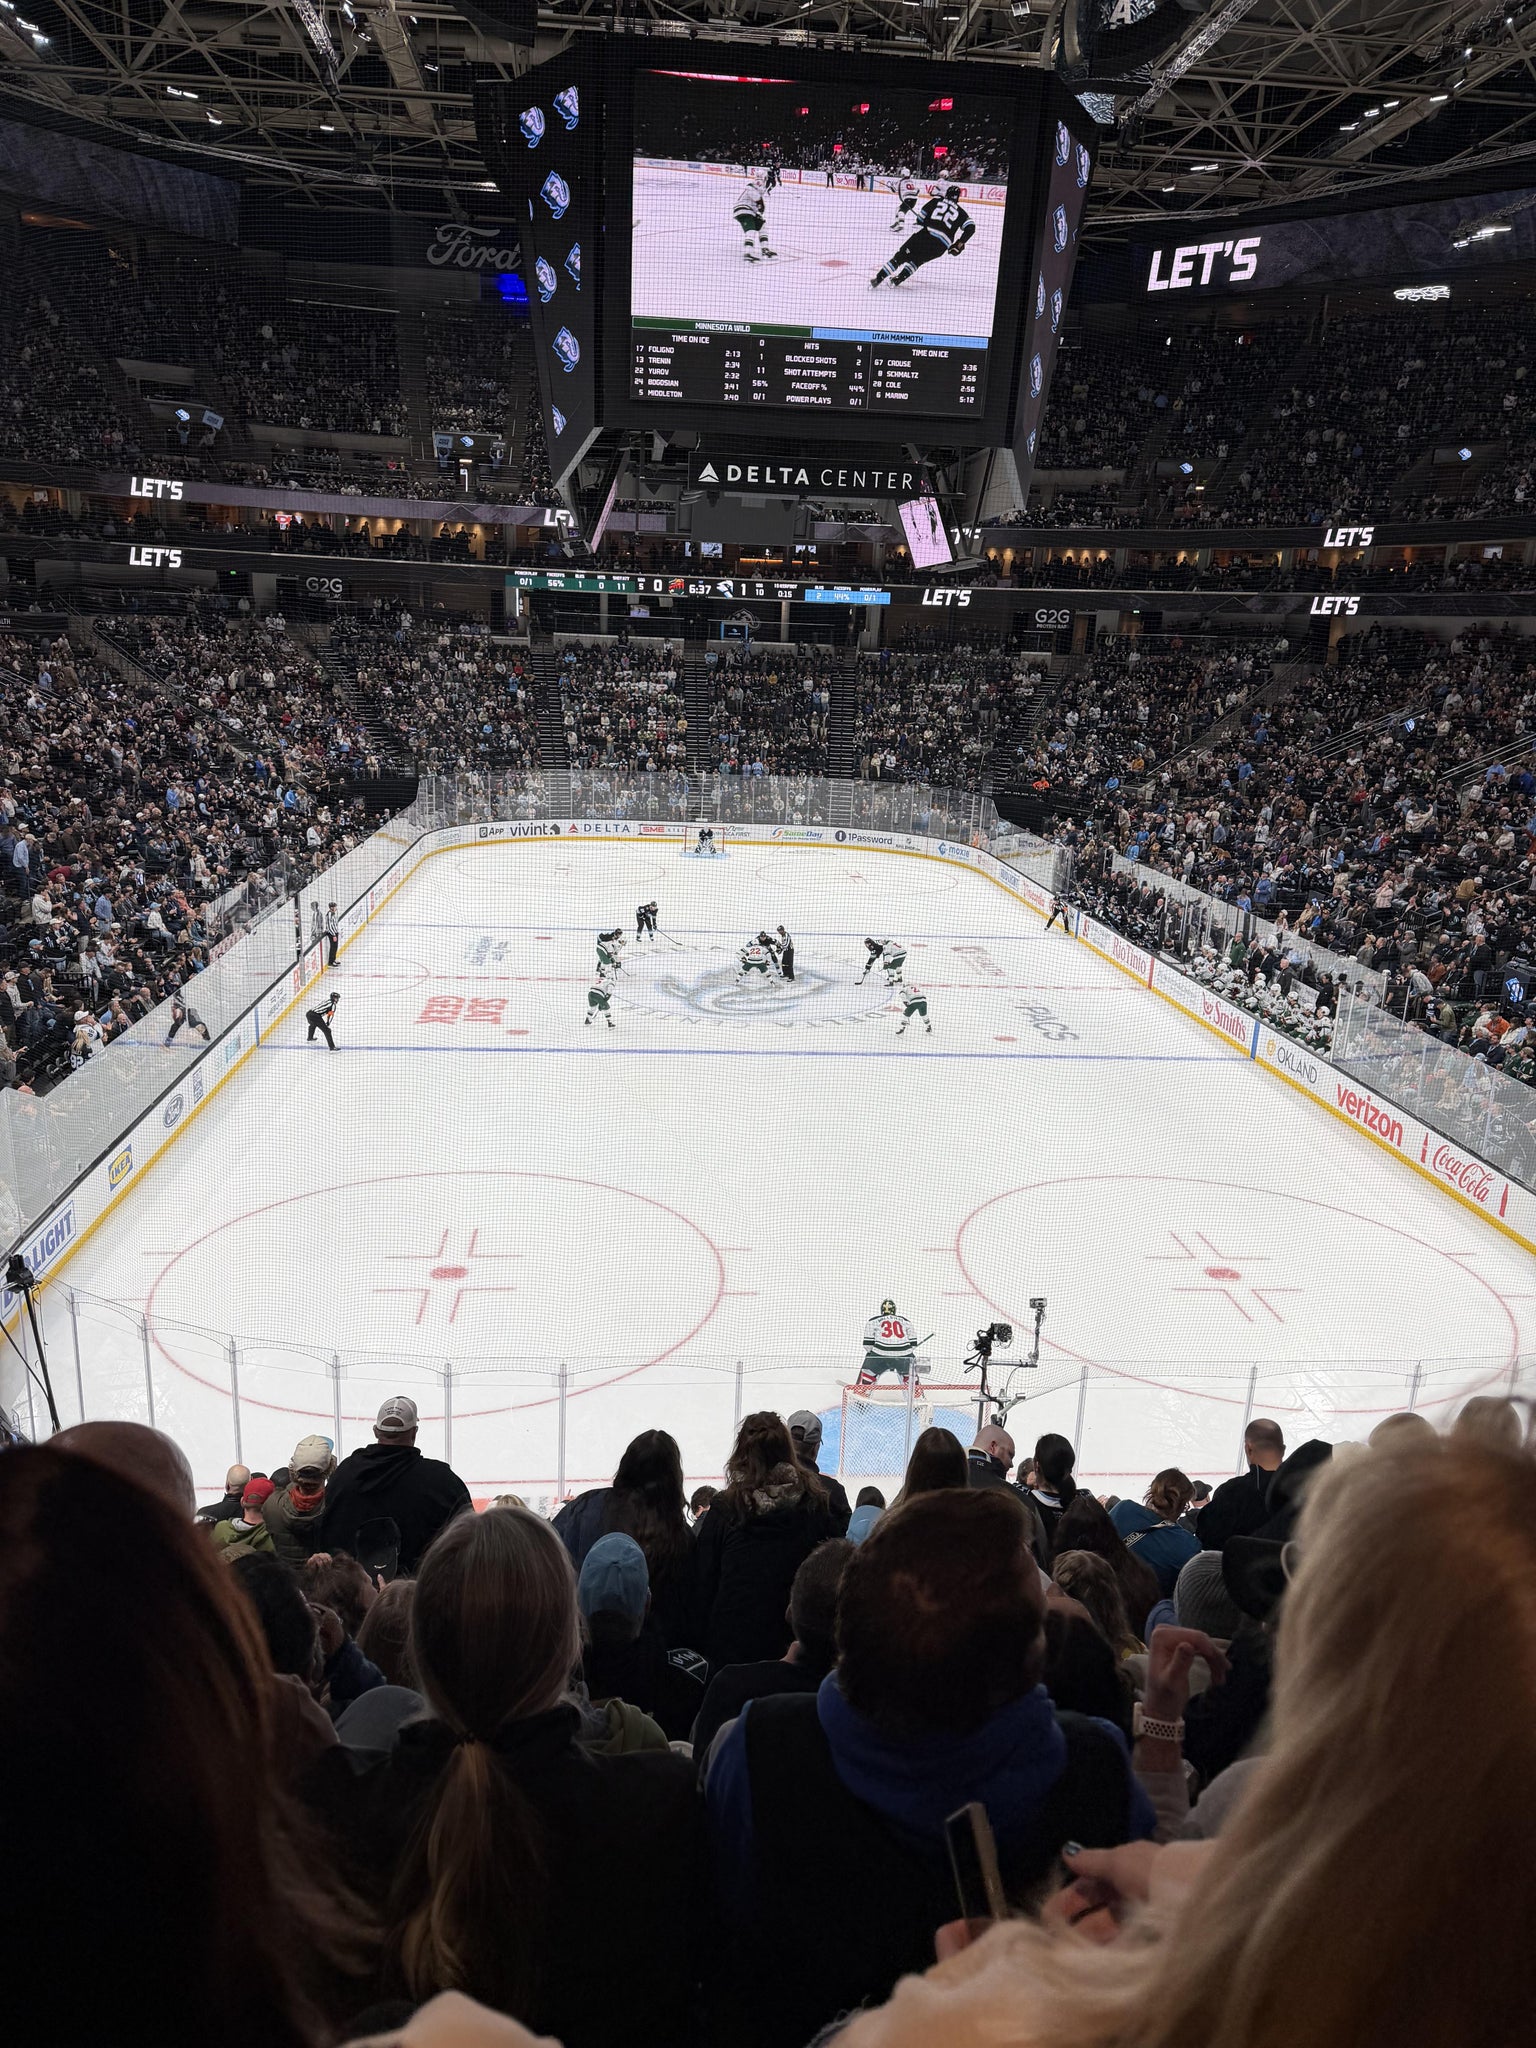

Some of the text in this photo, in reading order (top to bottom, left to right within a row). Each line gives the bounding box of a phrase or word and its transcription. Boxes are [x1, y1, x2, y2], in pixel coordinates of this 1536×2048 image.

[931, 202, 959, 230] 22
[426, 224, 522, 270] Ford
[1147, 237, 1261, 291] LET'S
[695, 322, 750, 333] MINNESOTA WILD
[672, 335, 710, 344] TIME ON ICE
[890, 334, 924, 343] MAMMOTH
[648, 346, 674, 354] FOLIGNO
[725, 350, 740, 358] 2:13
[804, 342, 820, 350] HITS
[786, 355, 814, 363] BLOCKED
[815, 356, 836, 364] SHOTS
[912, 349, 949, 358] TIME ON ICE
[888, 360, 912, 368] CROUSE
[962, 364, 978, 372] 3:36
[648, 368, 670, 376] YUROV
[724, 372, 740, 380] 2:32
[784, 368, 801, 376] SHOT
[802, 370, 836, 378] ATTEMPTS
[854, 372, 862, 380] 15
[886, 370, 919, 379] SCHMALTZ
[648, 378, 679, 387] BOGOSIAN
[792, 382, 820, 390] FACEOFF
[886, 381, 902, 389] COLE
[648, 390, 682, 398] MIDDLETON
[884, 392, 908, 400] MARINO
[960, 396, 974, 404] 5:12
[786, 395, 809, 403] POWER
[810, 396, 832, 404] PLAYS
[850, 398, 862, 406] 0/1
[727, 464, 913, 490] DELTA CENTER
[130, 477, 184, 500] LET'S
[1324, 527, 1374, 547] LET'S
[130, 547, 182, 568] LET'S
[306, 577, 342, 593] G2G
[520, 578, 532, 586] 0/1
[548, 580, 564, 588] 56%
[598, 582, 604, 590] 0
[654, 579, 662, 592] 0
[688, 584, 712, 596] 6:37
[740, 584, 747, 596] 1
[778, 590, 792, 598] 0:15
[864, 594, 876, 602] 0/1
[922, 589, 972, 606] LET'S
[1310, 596, 1360, 615] LET'S
[1035, 609, 1070, 624] G2G
[510, 823, 548, 836] vivint
[584, 824, 630, 833] DELTA
[848, 833, 893, 846] 1Password
[949, 846, 970, 858] moxie
[750, 948, 761, 956] 22
[1215, 1001, 1246, 1042] Smith's
[1277, 1046, 1318, 1084] OKLAND
[1337, 1084, 1404, 1147] verizon
[111, 1154, 131, 1181] IKEA
[1433, 1145, 1495, 1203] Coca-Cola
[32, 1210, 72, 1273] LIGHT
[881, 1320, 905, 1339] 30
